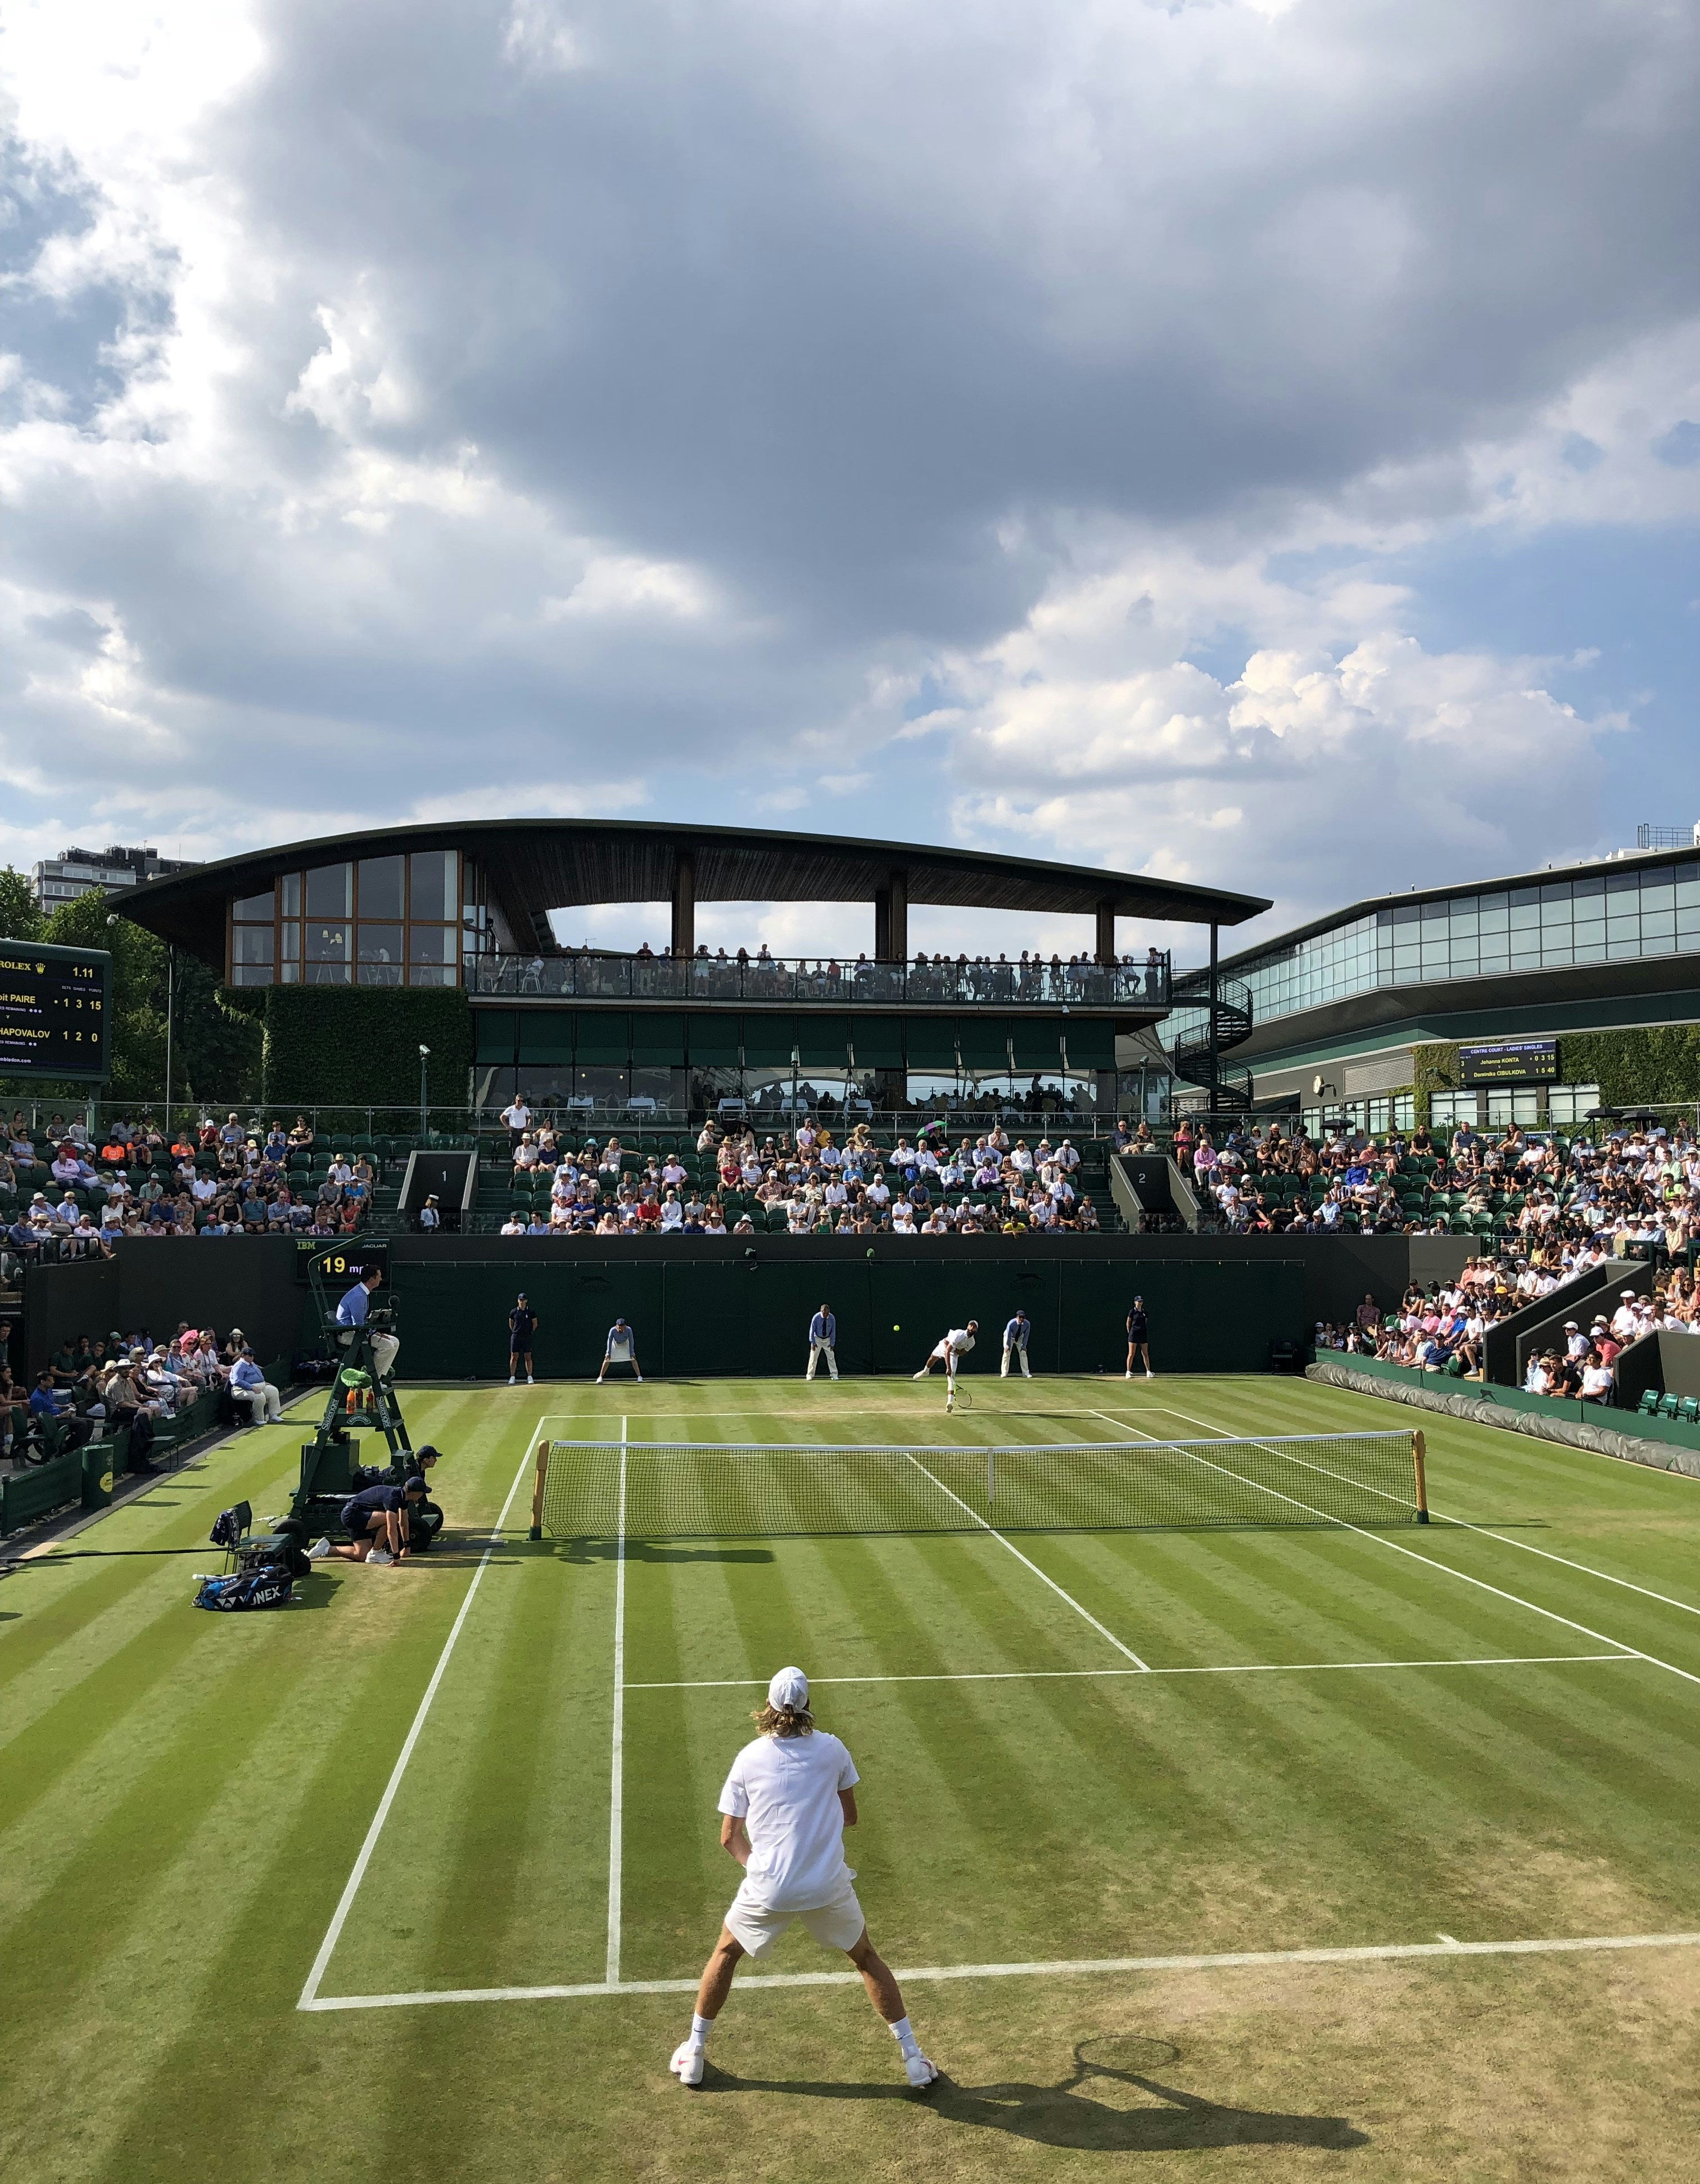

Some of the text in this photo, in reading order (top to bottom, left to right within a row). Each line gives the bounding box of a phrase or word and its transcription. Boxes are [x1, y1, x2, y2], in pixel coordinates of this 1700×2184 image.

[0, 961, 31, 970] ROLEX
[73, 967, 93, 978] 1.11
[11, 994, 36, 1004] PAIRE
[64, 998, 101, 1010] 1 3 15
[63, 1030, 98, 1042] 1 2 0
[442, 1170, 446, 1182] 1
[1138, 1173, 1146, 1183] 2
[297, 1241, 316, 1250] IBM
[322, 1398, 339, 1431] Slazenger
[377, 1396, 391, 1428] Slazenger
